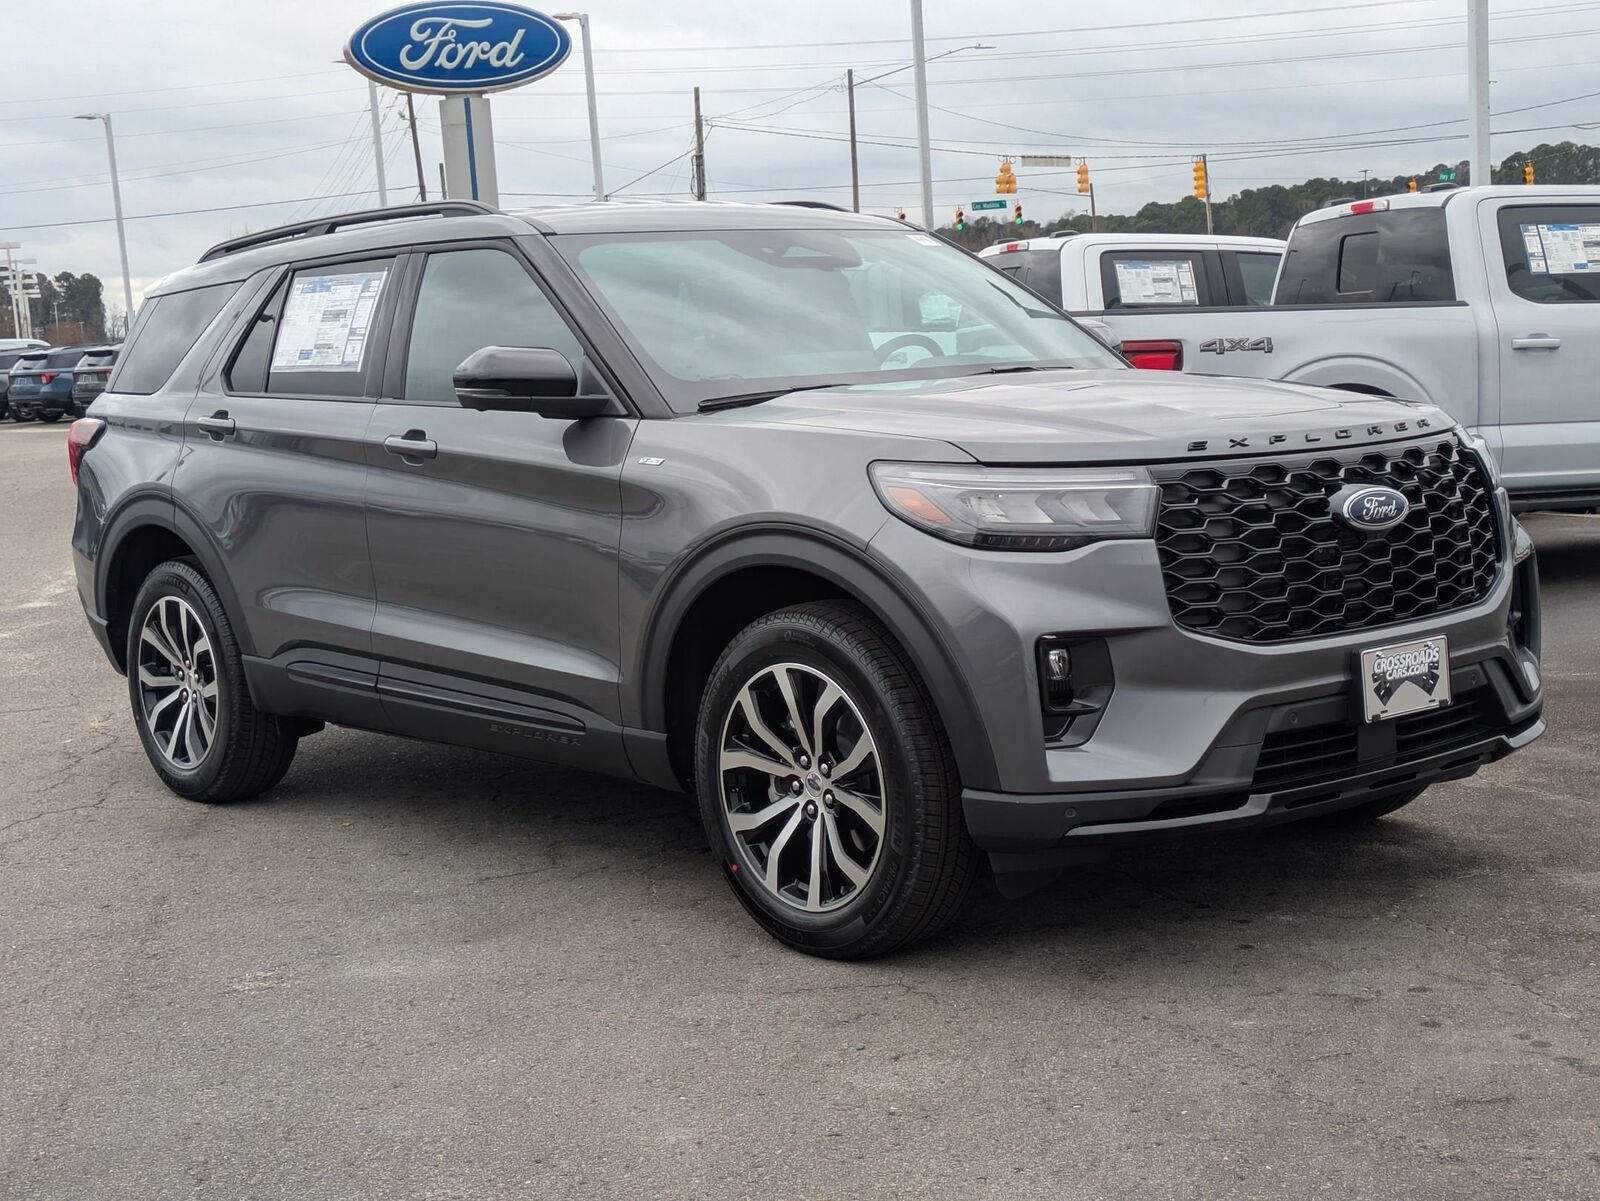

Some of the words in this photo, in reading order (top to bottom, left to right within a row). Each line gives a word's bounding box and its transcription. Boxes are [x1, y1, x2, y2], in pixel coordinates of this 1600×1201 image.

[400, 17, 527, 70] Ford
[1187, 418, 1431, 451] EXPLORER
[1363, 496, 1398, 520] Ford
[1374, 647, 1440, 674] CROSSROADS
[1386, 663, 1429, 680] CARS.COM
